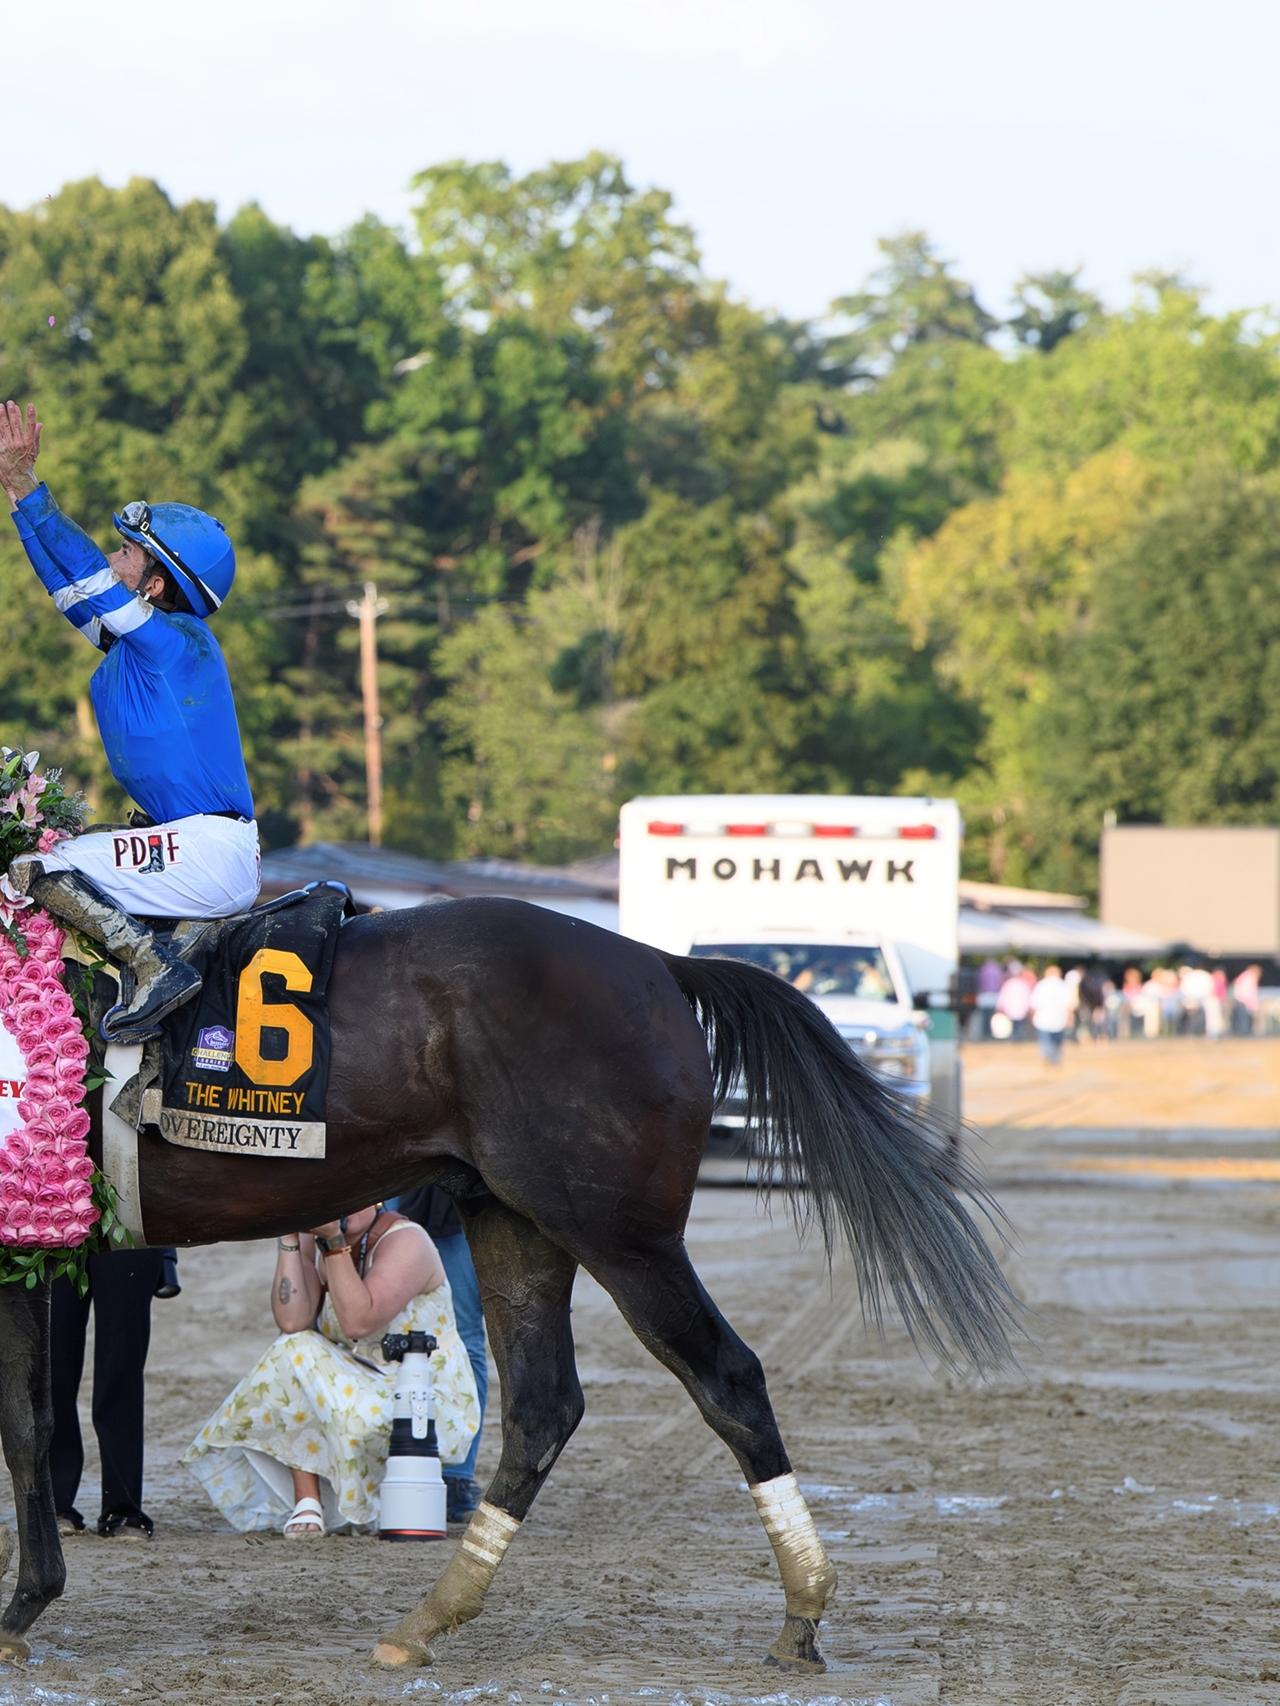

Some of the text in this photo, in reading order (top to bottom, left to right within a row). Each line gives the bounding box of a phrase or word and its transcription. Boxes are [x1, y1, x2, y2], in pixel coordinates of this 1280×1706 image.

[667, 857, 914, 882] MOHAWK
[235, 948, 313, 1086] 6
[192, 1048, 234, 1062] CHALLEN
[186, 1081, 305, 1115] THE WHITNEY
